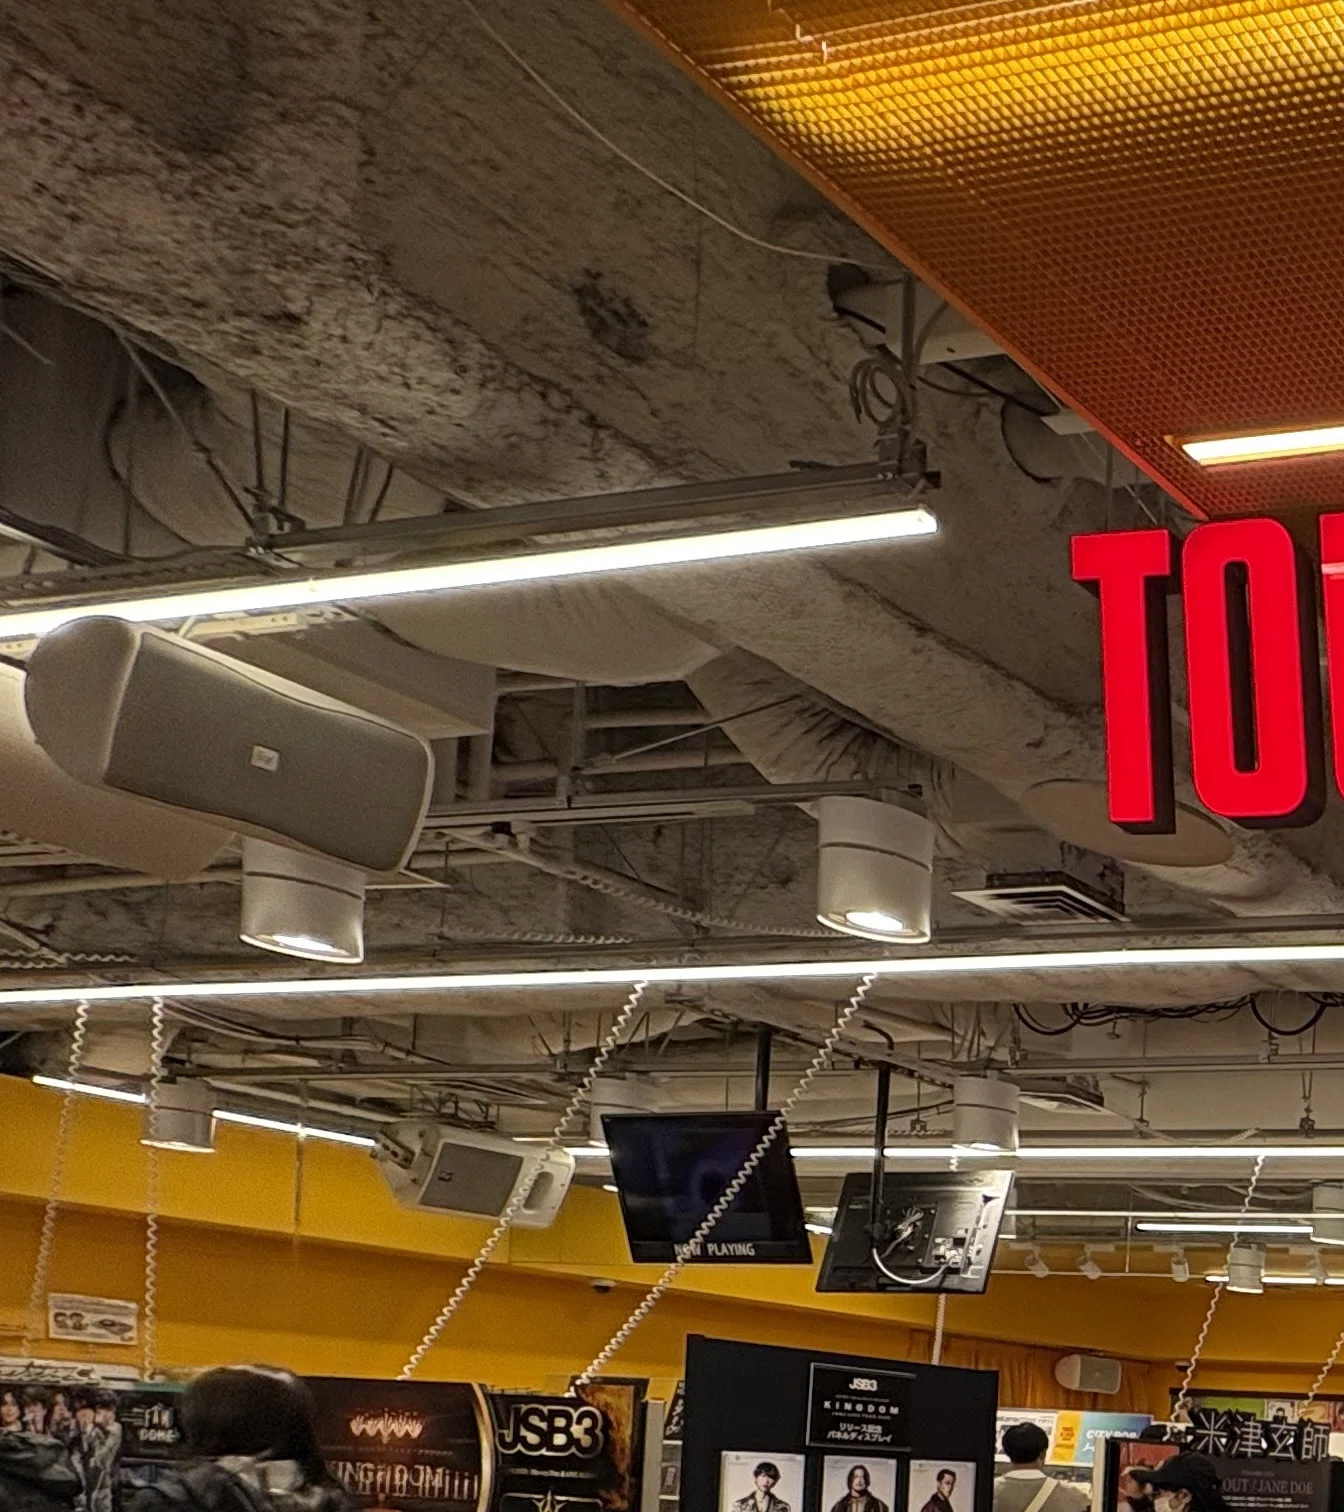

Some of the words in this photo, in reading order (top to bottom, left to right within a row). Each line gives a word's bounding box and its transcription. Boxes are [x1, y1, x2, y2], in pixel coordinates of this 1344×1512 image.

[707, 1243, 756, 1257] PLAYING
[823, 1400, 900, 1415] KINGDOM
[497, 1404, 604, 1457] JSB3
[1196, 1411, 1330, 1463] 米津玄師
[1258, 1478, 1288, 1494] JANE
